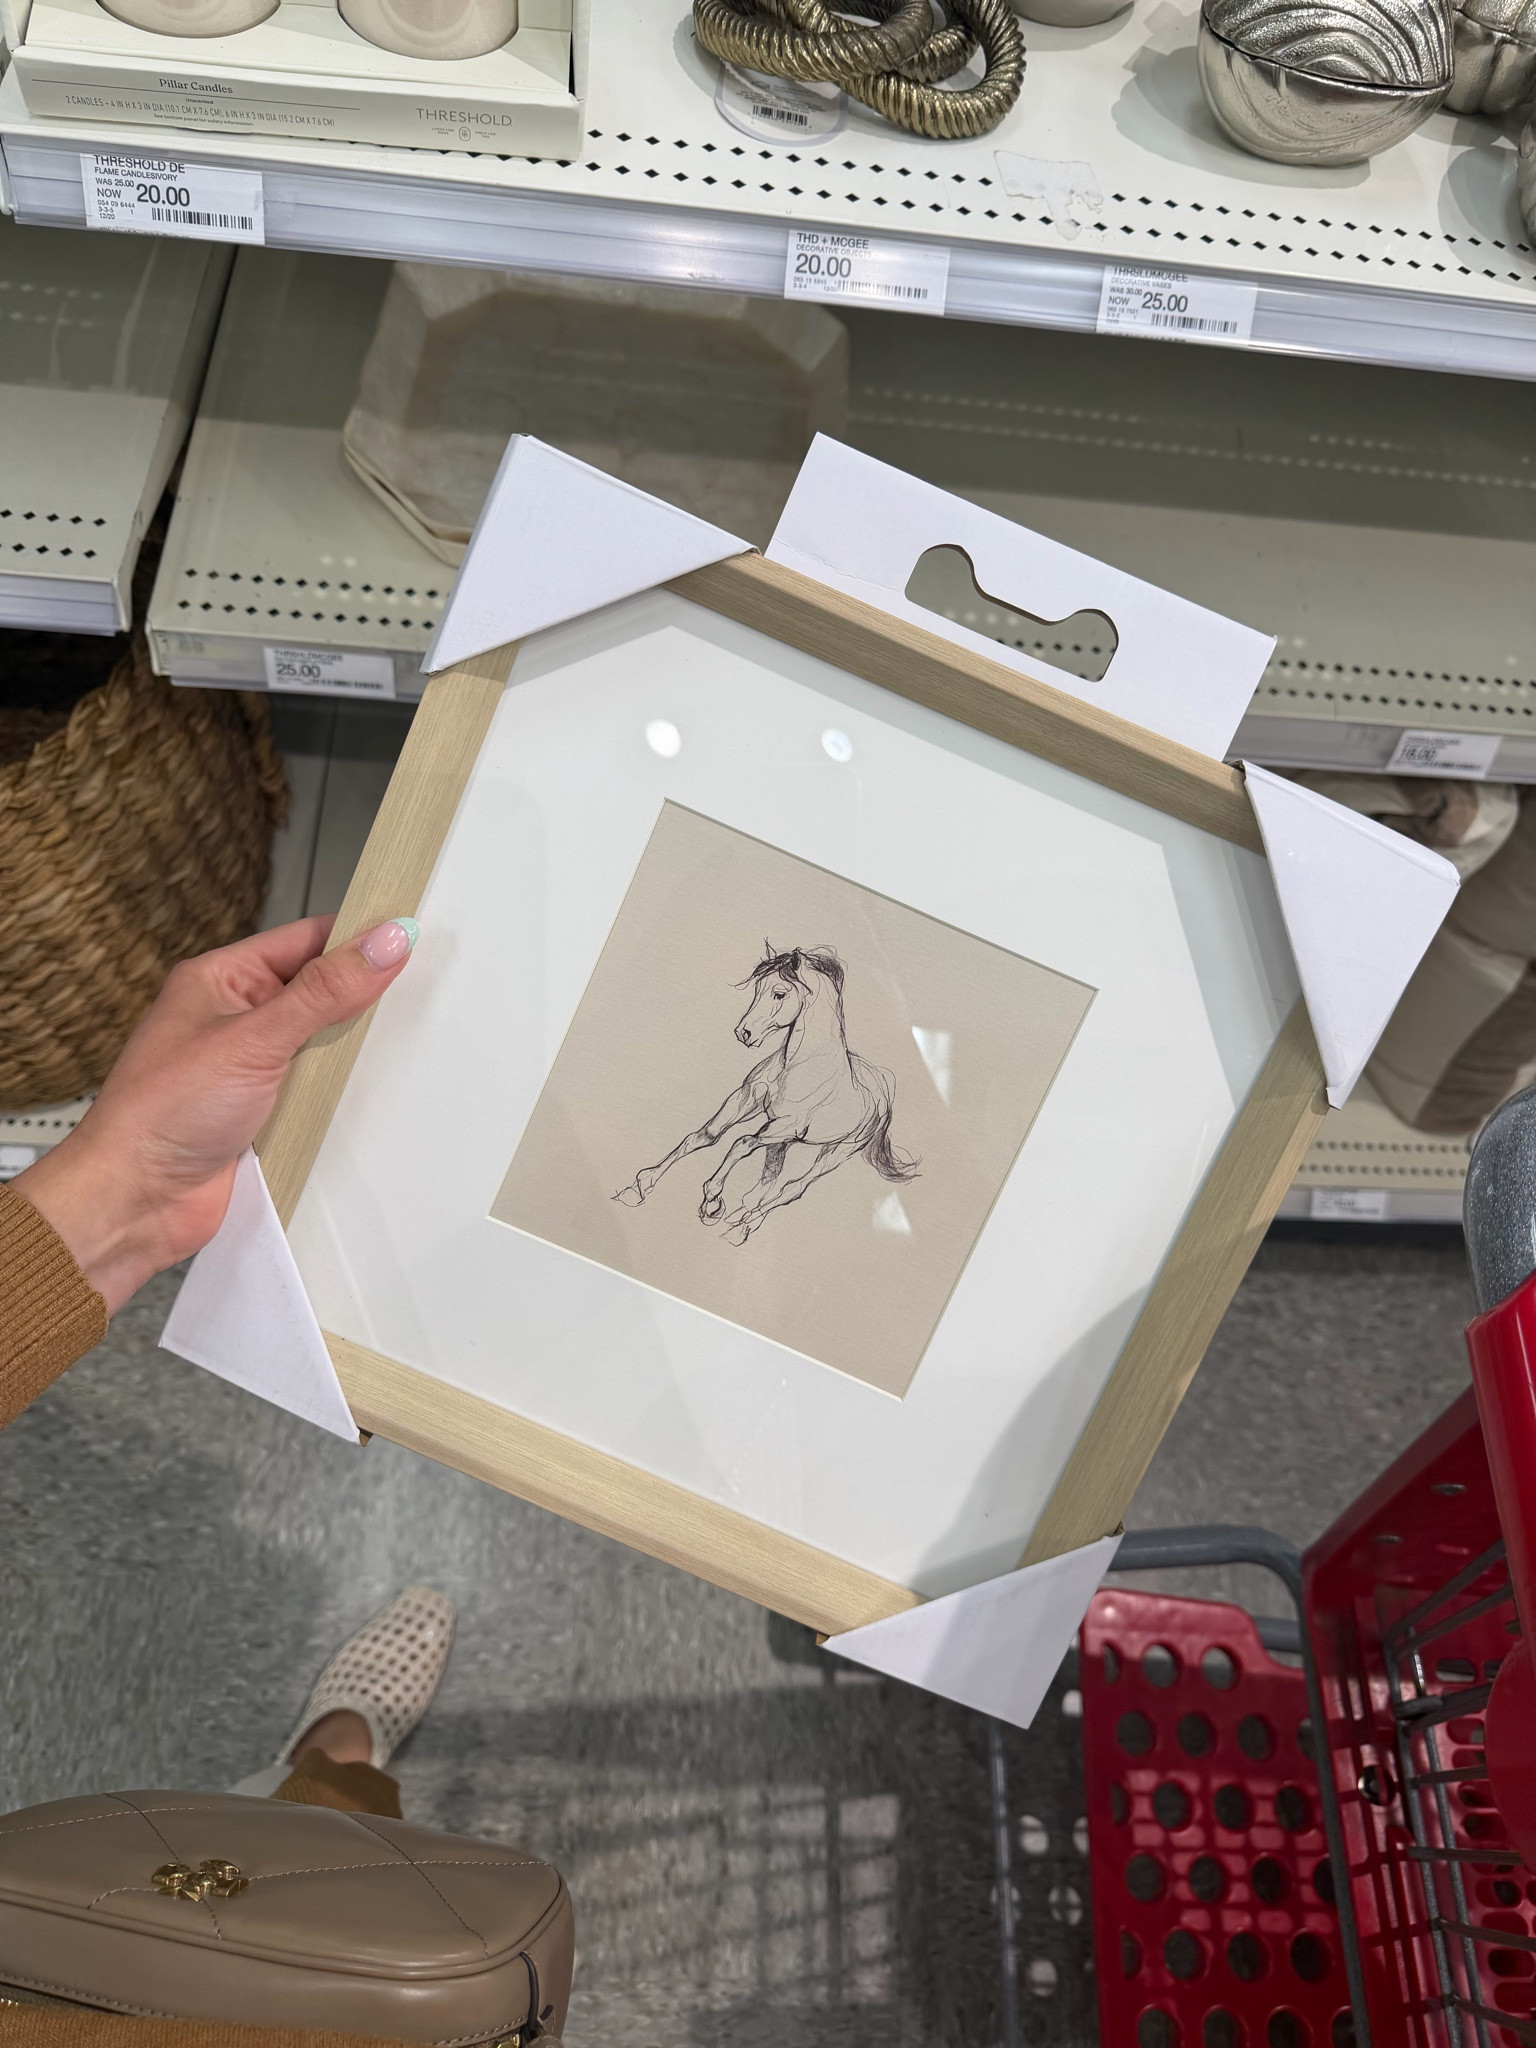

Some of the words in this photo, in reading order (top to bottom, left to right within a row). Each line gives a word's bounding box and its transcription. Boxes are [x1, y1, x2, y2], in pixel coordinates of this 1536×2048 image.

[159, 79, 189, 90] Pillar
[191, 82, 234, 94] Candles
[66, 96, 71, 104] 2
[72, 96, 104, 107] CANDLES
[132, 102, 137, 110] X
[138, 102, 142, 110] 3
[153, 103, 165, 112] DIA
[182, 106, 192, 114] CM
[193, 107, 198, 115] X
[226, 110, 230, 118] 6
[231, 110, 239, 119] IN
[240, 111, 245, 119] H
[246, 112, 251, 120] X
[252, 112, 256, 120] 3
[257, 112, 265, 121] IN
[266, 113, 277, 122] DIA
[296, 116, 305, 124] CM
[307, 117, 311, 125] X
[323, 118, 335, 127] CM)
[94, 155, 166, 172] THRESHOLD
[170, 163, 185, 174] DE
[95, 167, 119, 176] FLAME
[121, 170, 178, 182] CANDLESIVORY
[96, 178, 112, 186] WAS
[115, 179, 135, 188] 25.00
[97, 189, 122, 199] NOW
[137, 184, 190, 207] 20.00
[796, 244, 839, 254] DECORATIVE
[798, 233, 819, 244] THD
[831, 236, 869, 250] MCGEE
[796, 253, 852, 278] 20.00
[1112, 278, 1151, 288] DECORATIVE
[1152, 281, 1172, 290] VASES
[1109, 296, 1130, 306] NOW
[1142, 292, 1188, 313] 25.00
[277, 663, 321, 678] 25.00
